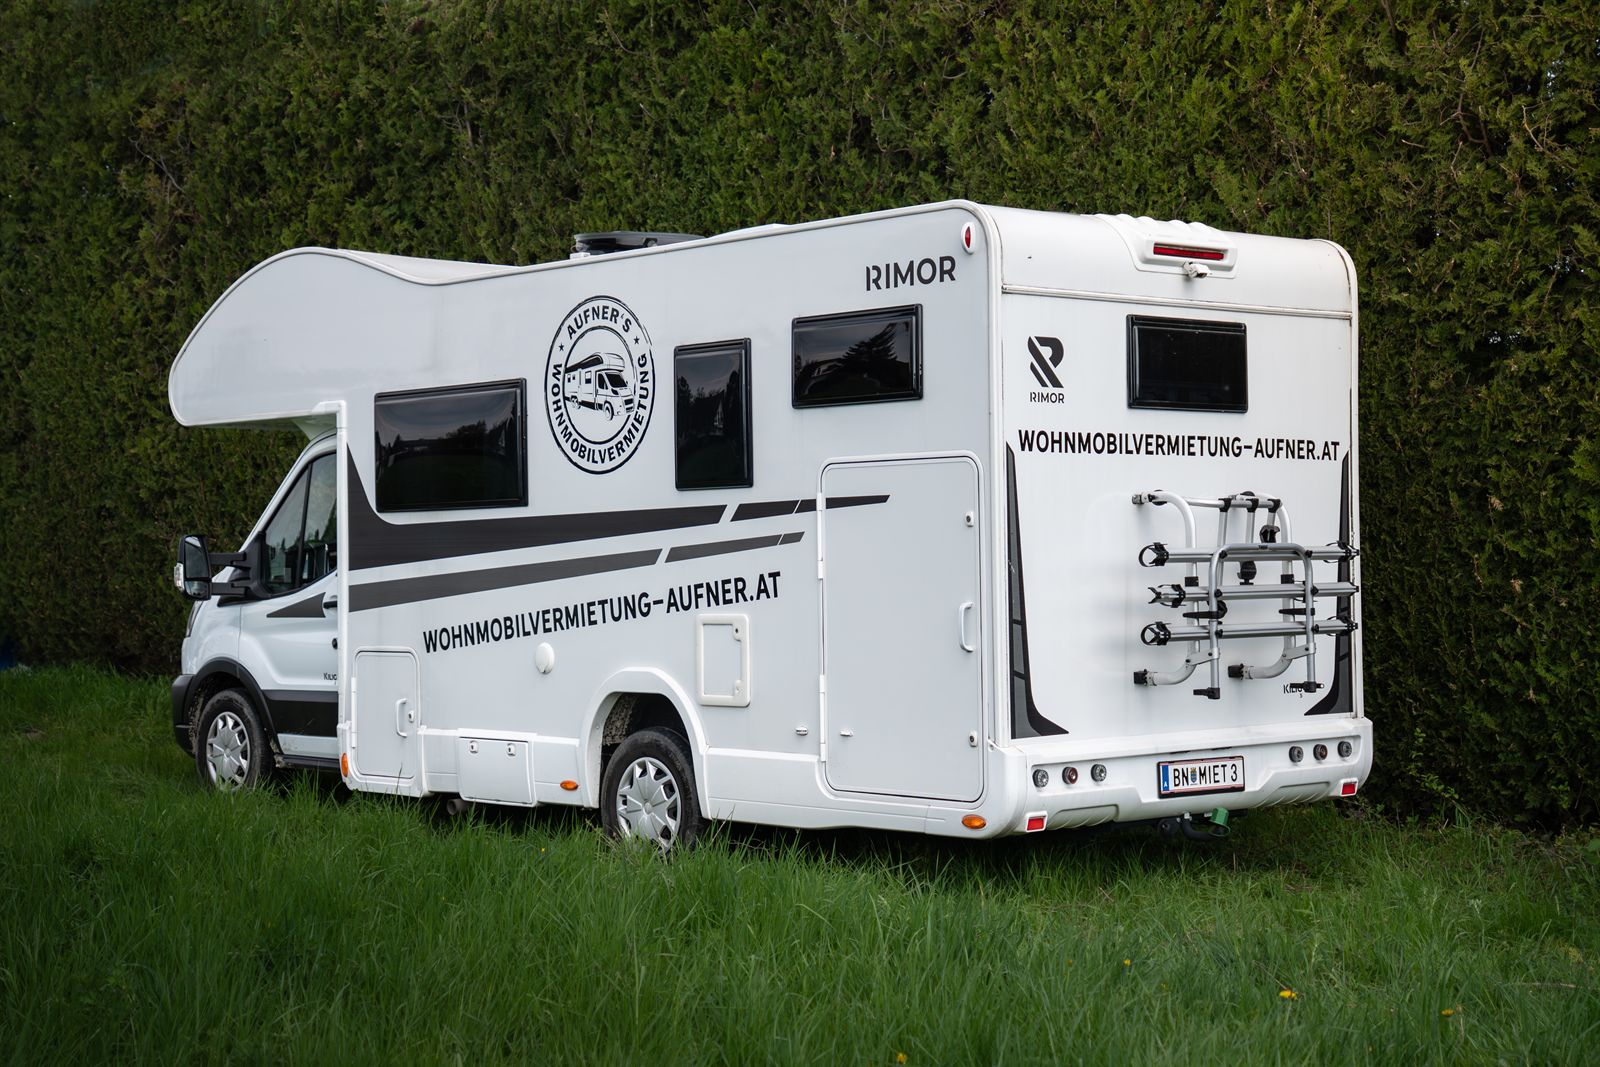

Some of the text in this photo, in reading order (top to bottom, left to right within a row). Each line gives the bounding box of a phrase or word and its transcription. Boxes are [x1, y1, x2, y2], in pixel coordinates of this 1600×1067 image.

[866, 255, 956, 291] RIMOR
[566, 305, 632, 340] AUFNER'S
[551, 353, 650, 464] WOHNMOBILVERMIETUNG
[1029, 391, 1065, 404] RIMOR
[1018, 429, 1340, 461] WOHNMOBILVERMIETUNG-AUFNER.AT
[422, 571, 781, 654] WOHNMOBILVERMIETUNG-AUFNER.AT
[1173, 763, 1238, 787] BN MIET 3
